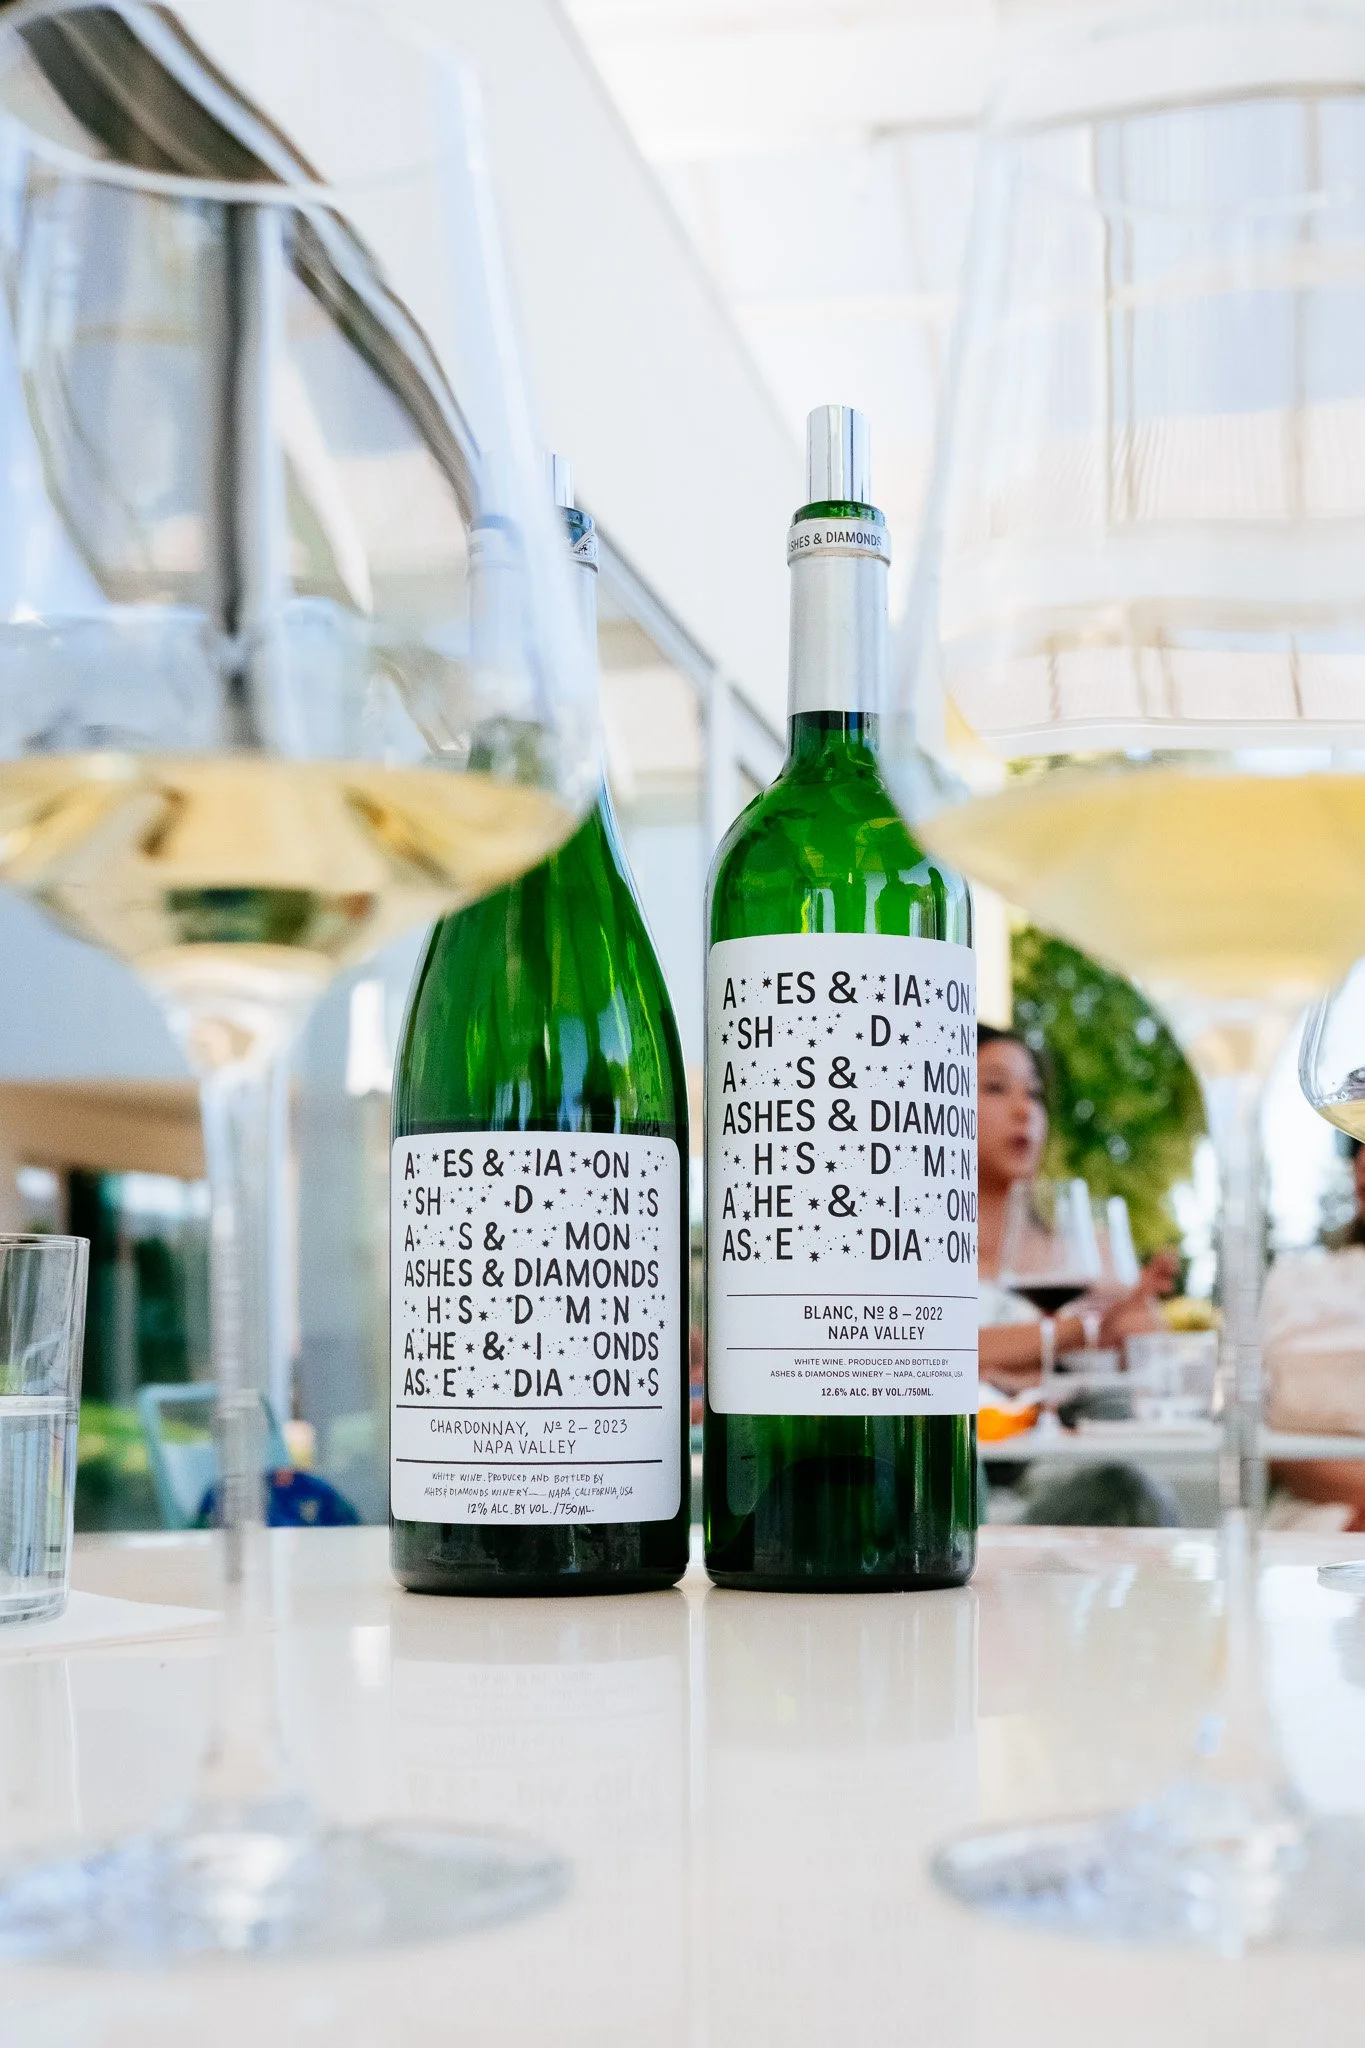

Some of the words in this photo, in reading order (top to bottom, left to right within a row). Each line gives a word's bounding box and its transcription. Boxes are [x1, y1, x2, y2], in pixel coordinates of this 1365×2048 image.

[788, 535, 810, 552] SHES
[813, 533, 822, 544] &
[826, 531, 881, 546] DIAMONDS
[777, 971, 815, 1004] ES
[895, 974, 921, 1007] IA
[947, 980, 969, 1015] ON
[738, 1016, 772, 1049] SH
[925, 1061, 969, 1097] MON
[723, 1099, 815, 1135] ASHES
[444, 1149, 473, 1178] ES
[536, 1148, 562, 1177] IA
[593, 1150, 628, 1178] ON
[416, 1187, 440, 1216] SH
[754, 1185, 793, 1217] HE
[566, 1222, 630, 1251] MON
[723, 1229, 751, 1261] AS
[871, 1228, 922, 1261] DIA
[947, 1231, 970, 1263] ON
[405, 1259, 472, 1287] ASHES
[515, 1258, 658, 1288] DIAMONDS
[804, 1305, 858, 1323] BLANC,
[915, 1306, 943, 1321] 2022
[428, 1332, 456, 1360] HE
[594, 1332, 658, 1361] ONDS
[828, 1325, 869, 1340] NAPA
[873, 1325, 925, 1341] VALLEY
[770, 1370, 796, 1378] ASHES
[804, 1370, 850, 1378] DIAMONDS
[851, 1370, 884, 1378] WINERY
[893, 1370, 916, 1378] NAPA,
[916, 1370, 954, 1378] CALIFORNIA,
[953, 1370, 963, 1378] USA
[794, 1358, 820, 1366] WHITE
[821, 1358, 847, 1366] WINE.
[848, 1358, 894, 1366] PRODUCED
[894, 1358, 911, 1366] AND
[911, 1358, 941, 1366] BOTTLED
[941, 1358, 949, 1366] BY
[404, 1368, 425, 1396] AS
[514, 1369, 563, 1397] DIA
[593, 1369, 630, 1397] ON
[821, 1387, 848, 1397] 12.6%
[849, 1387, 870, 1397] ALC.
[871, 1387, 884, 1397] BY
[430, 1418, 529, 1438] CHARDONNAY,
[568, 1419, 576, 1434] 2
[594, 1418, 628, 1435] 2023
[473, 1439, 514, 1455] NAPA
[518, 1439, 577, 1455] VALLEY
